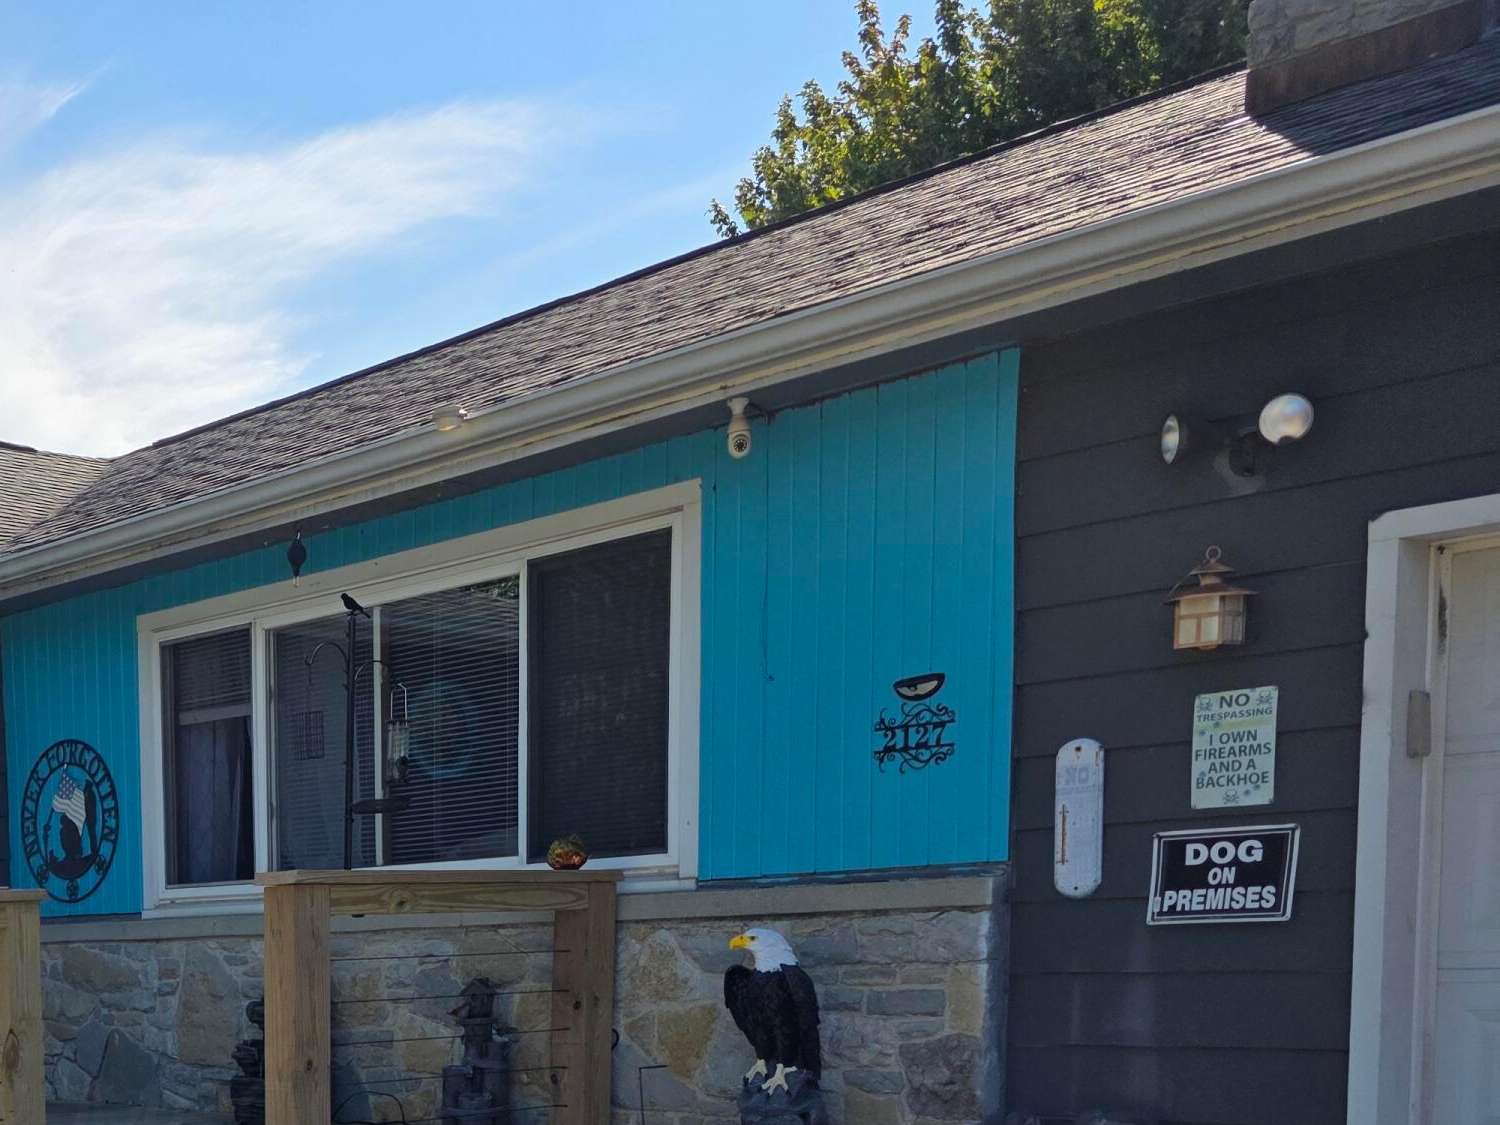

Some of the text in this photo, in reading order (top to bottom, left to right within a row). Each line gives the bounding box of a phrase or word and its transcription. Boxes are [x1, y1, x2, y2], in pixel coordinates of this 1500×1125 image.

[1219, 693, 1250, 709] NO
[1196, 707, 1273, 722] TRESPASSING
[884, 722, 946, 752] 2127
[1209, 729, 1258, 746] I OWN
[1195, 742, 1272, 761] FIREARMS
[1208, 758, 1256, 774] AND A
[1196, 771, 1269, 789] BACKHOE
[21, 741, 117, 860] NEVER FORGOTTEN
[1185, 839, 1263, 866] DOG
[1207, 867, 1236, 885] ON
[1162, 885, 1276, 912] PREMISES
